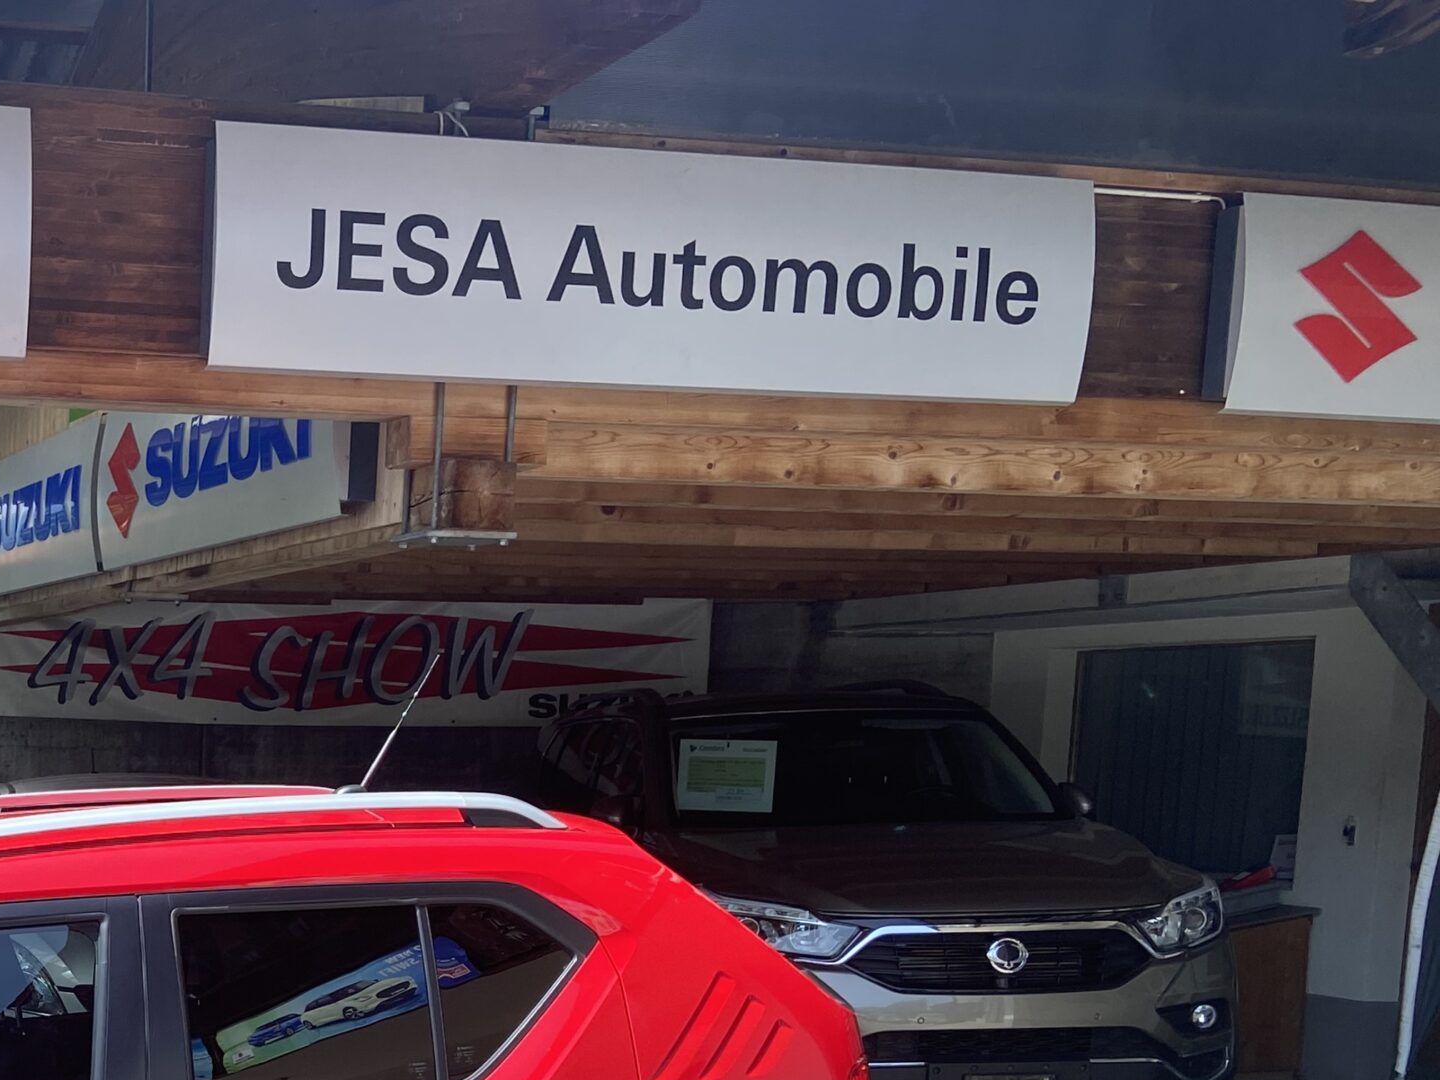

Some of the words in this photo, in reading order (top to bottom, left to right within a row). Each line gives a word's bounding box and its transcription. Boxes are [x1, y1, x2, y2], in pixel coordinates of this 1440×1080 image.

[276, 208, 521, 300] JESA
[546, 225, 1039, 325] Automobile
[242, 608, 535, 712] SHOW
